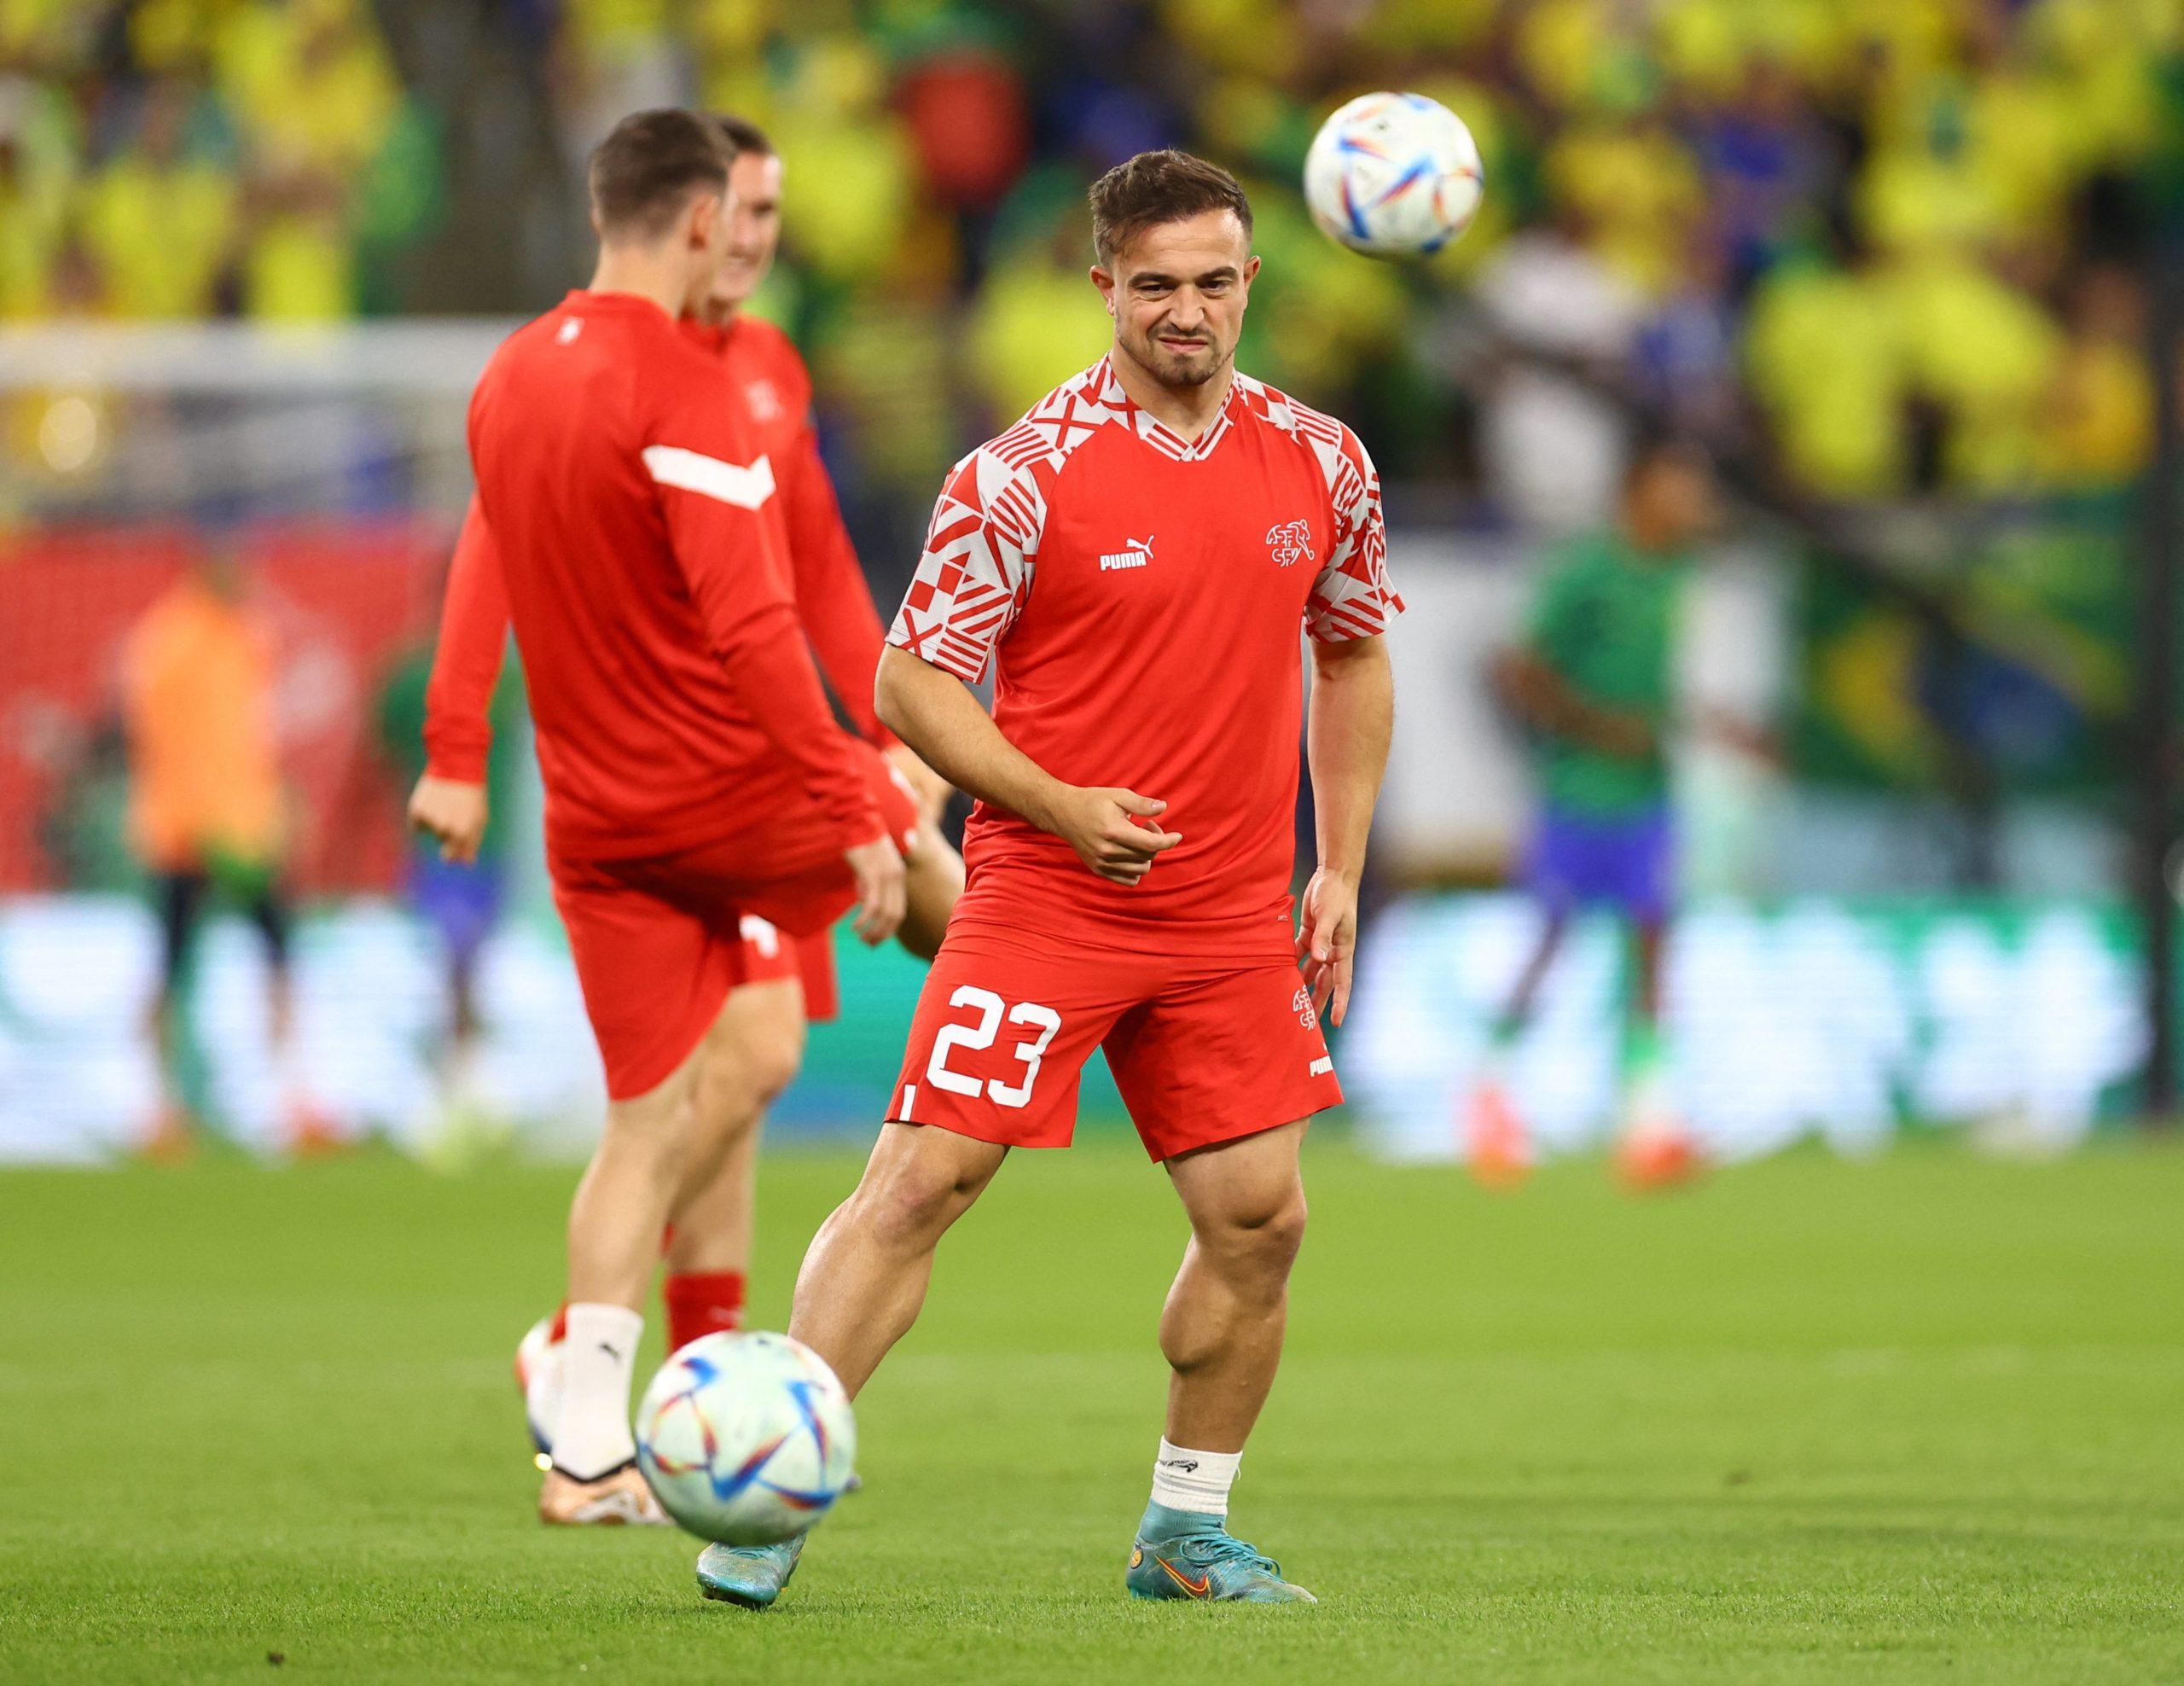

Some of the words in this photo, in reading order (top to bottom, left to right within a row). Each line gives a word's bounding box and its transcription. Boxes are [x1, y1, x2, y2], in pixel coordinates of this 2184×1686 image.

[1100, 550, 1147, 572] PUMA
[926, 985, 1062, 1108] 23
[1310, 1055, 1333, 1077] PUM
